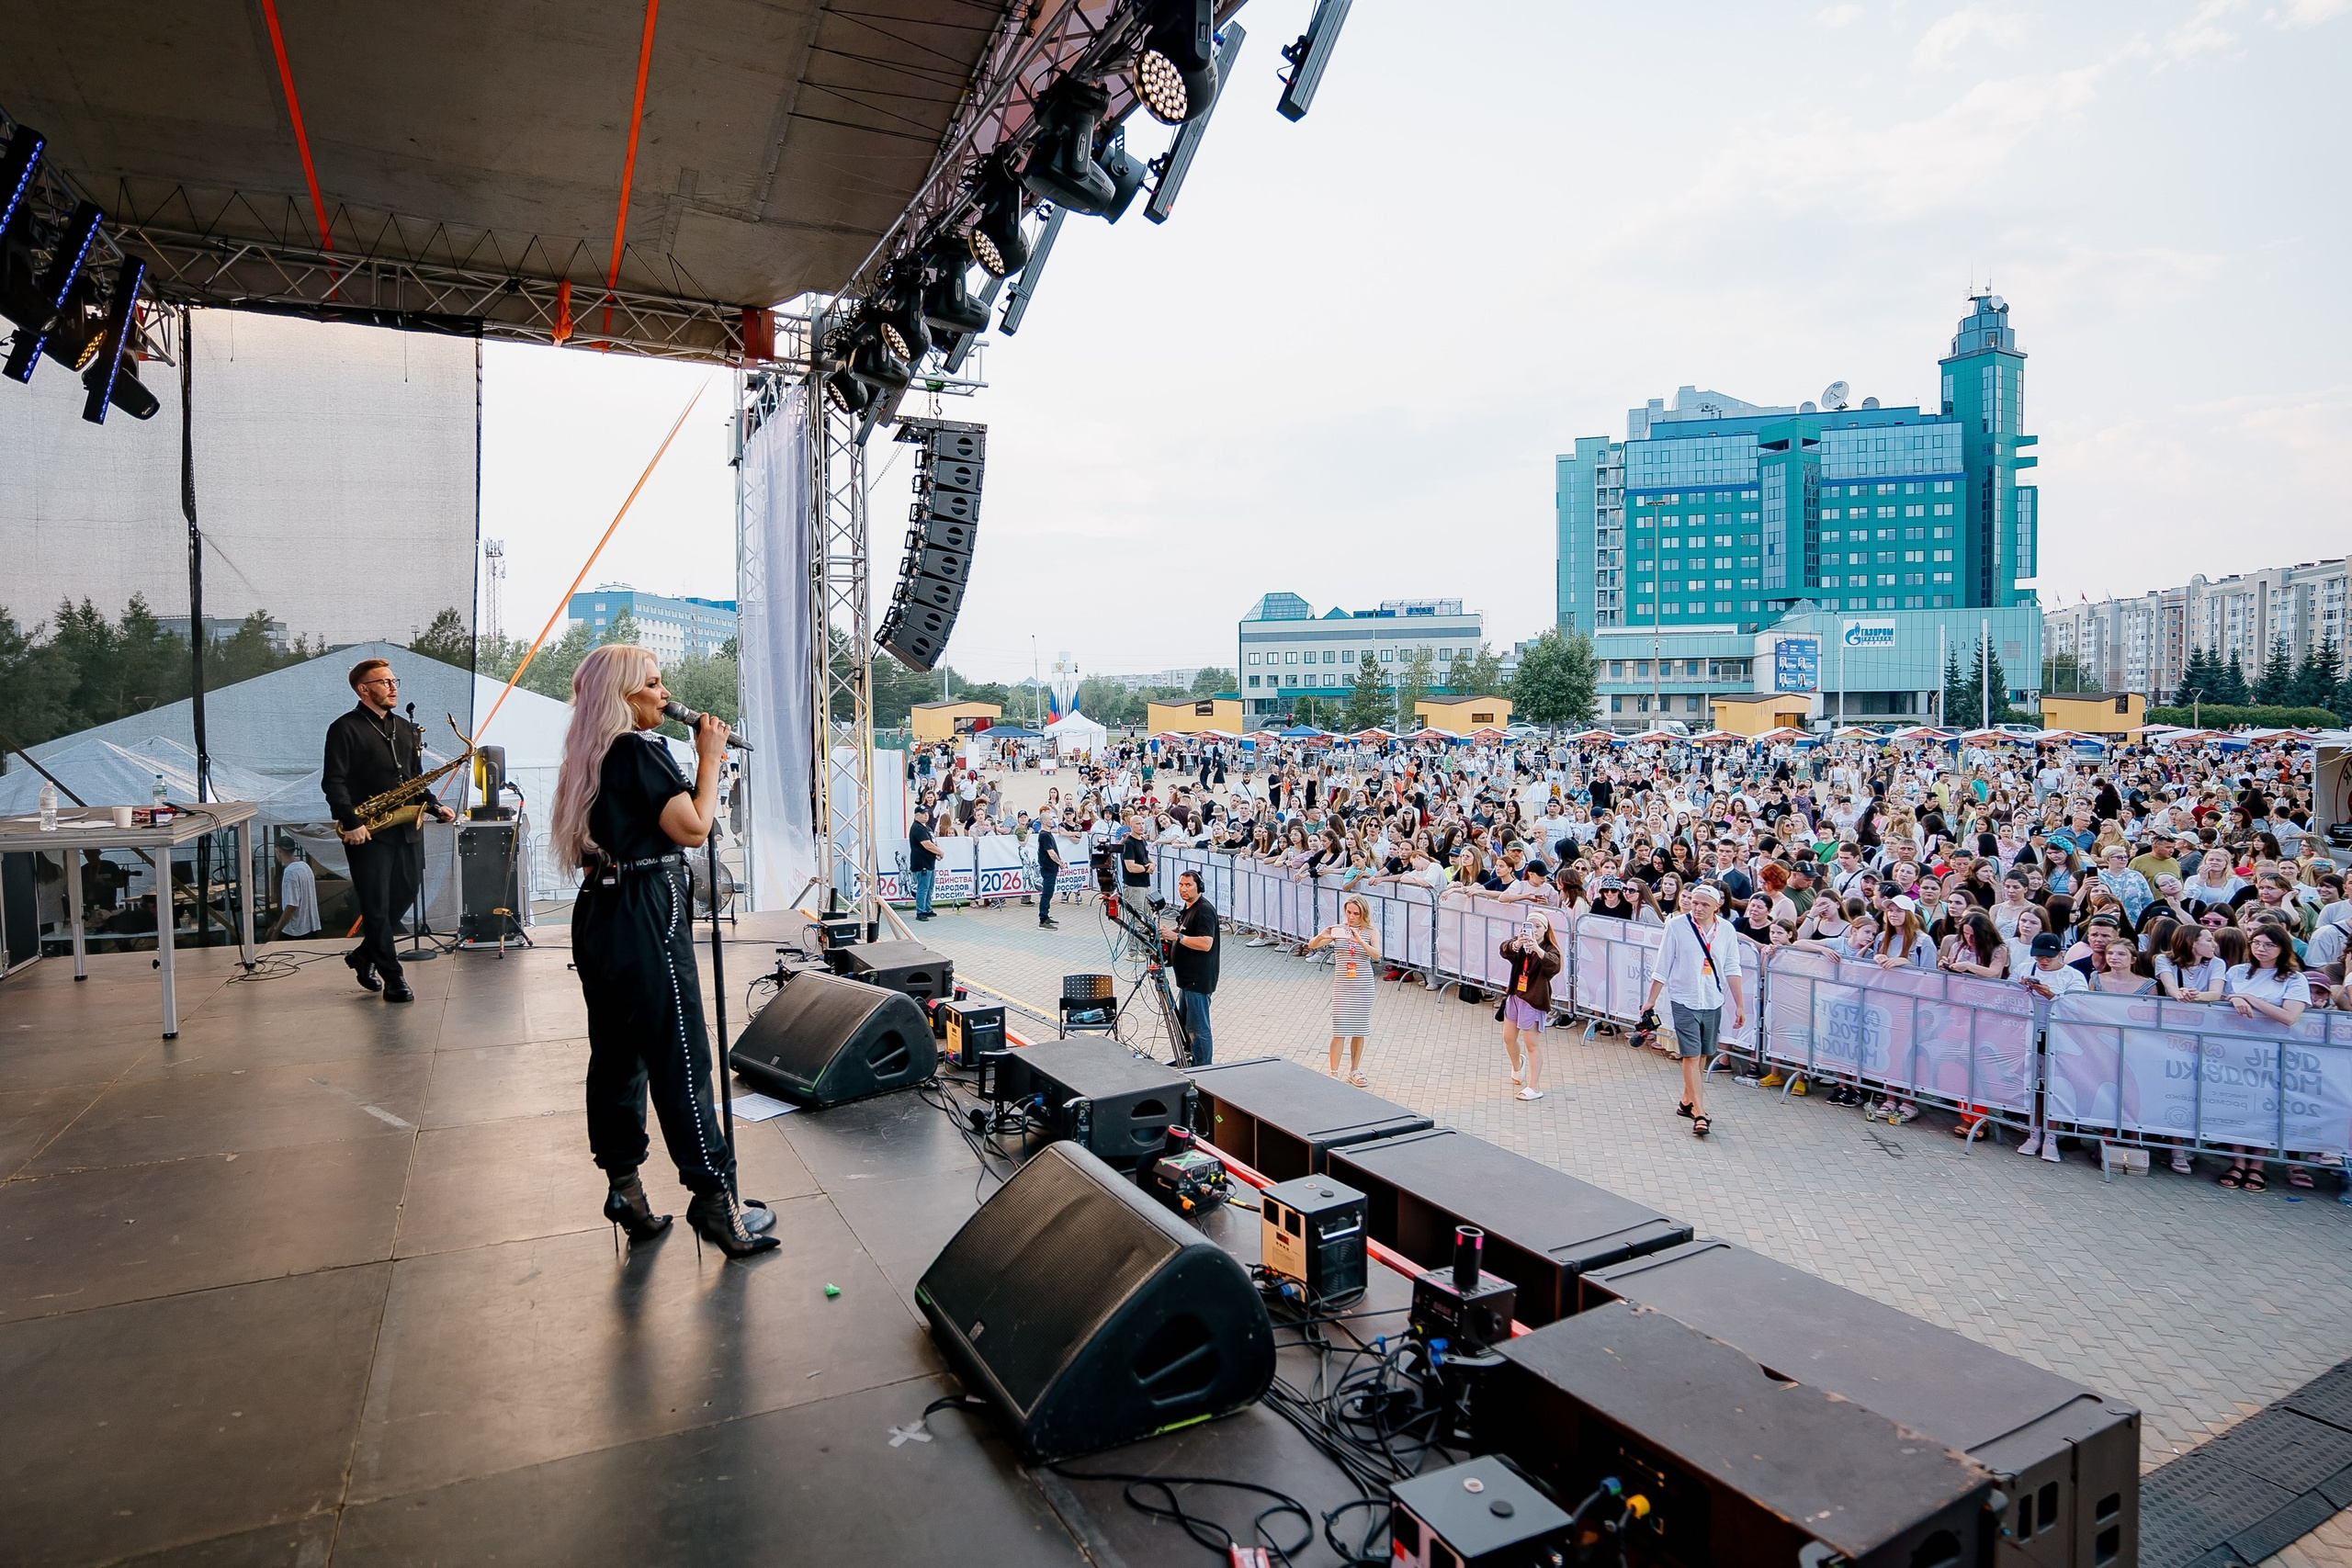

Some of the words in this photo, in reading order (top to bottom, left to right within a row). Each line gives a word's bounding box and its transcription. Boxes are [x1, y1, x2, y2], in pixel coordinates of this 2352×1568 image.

[1860, 627, 1894, 636] ГАЗПРОМ
[934, 876, 972, 885] ЕДИНСТВА
[981, 871, 1022, 892] 2026
[1057, 875, 1086, 884] НАРОДОВ
[876, 876, 897, 896] 26
[935, 884, 969, 892] НАРОДОВ
[1057, 883, 1082, 891] РОССИИ
[935, 891, 965, 899] РОССИИ
